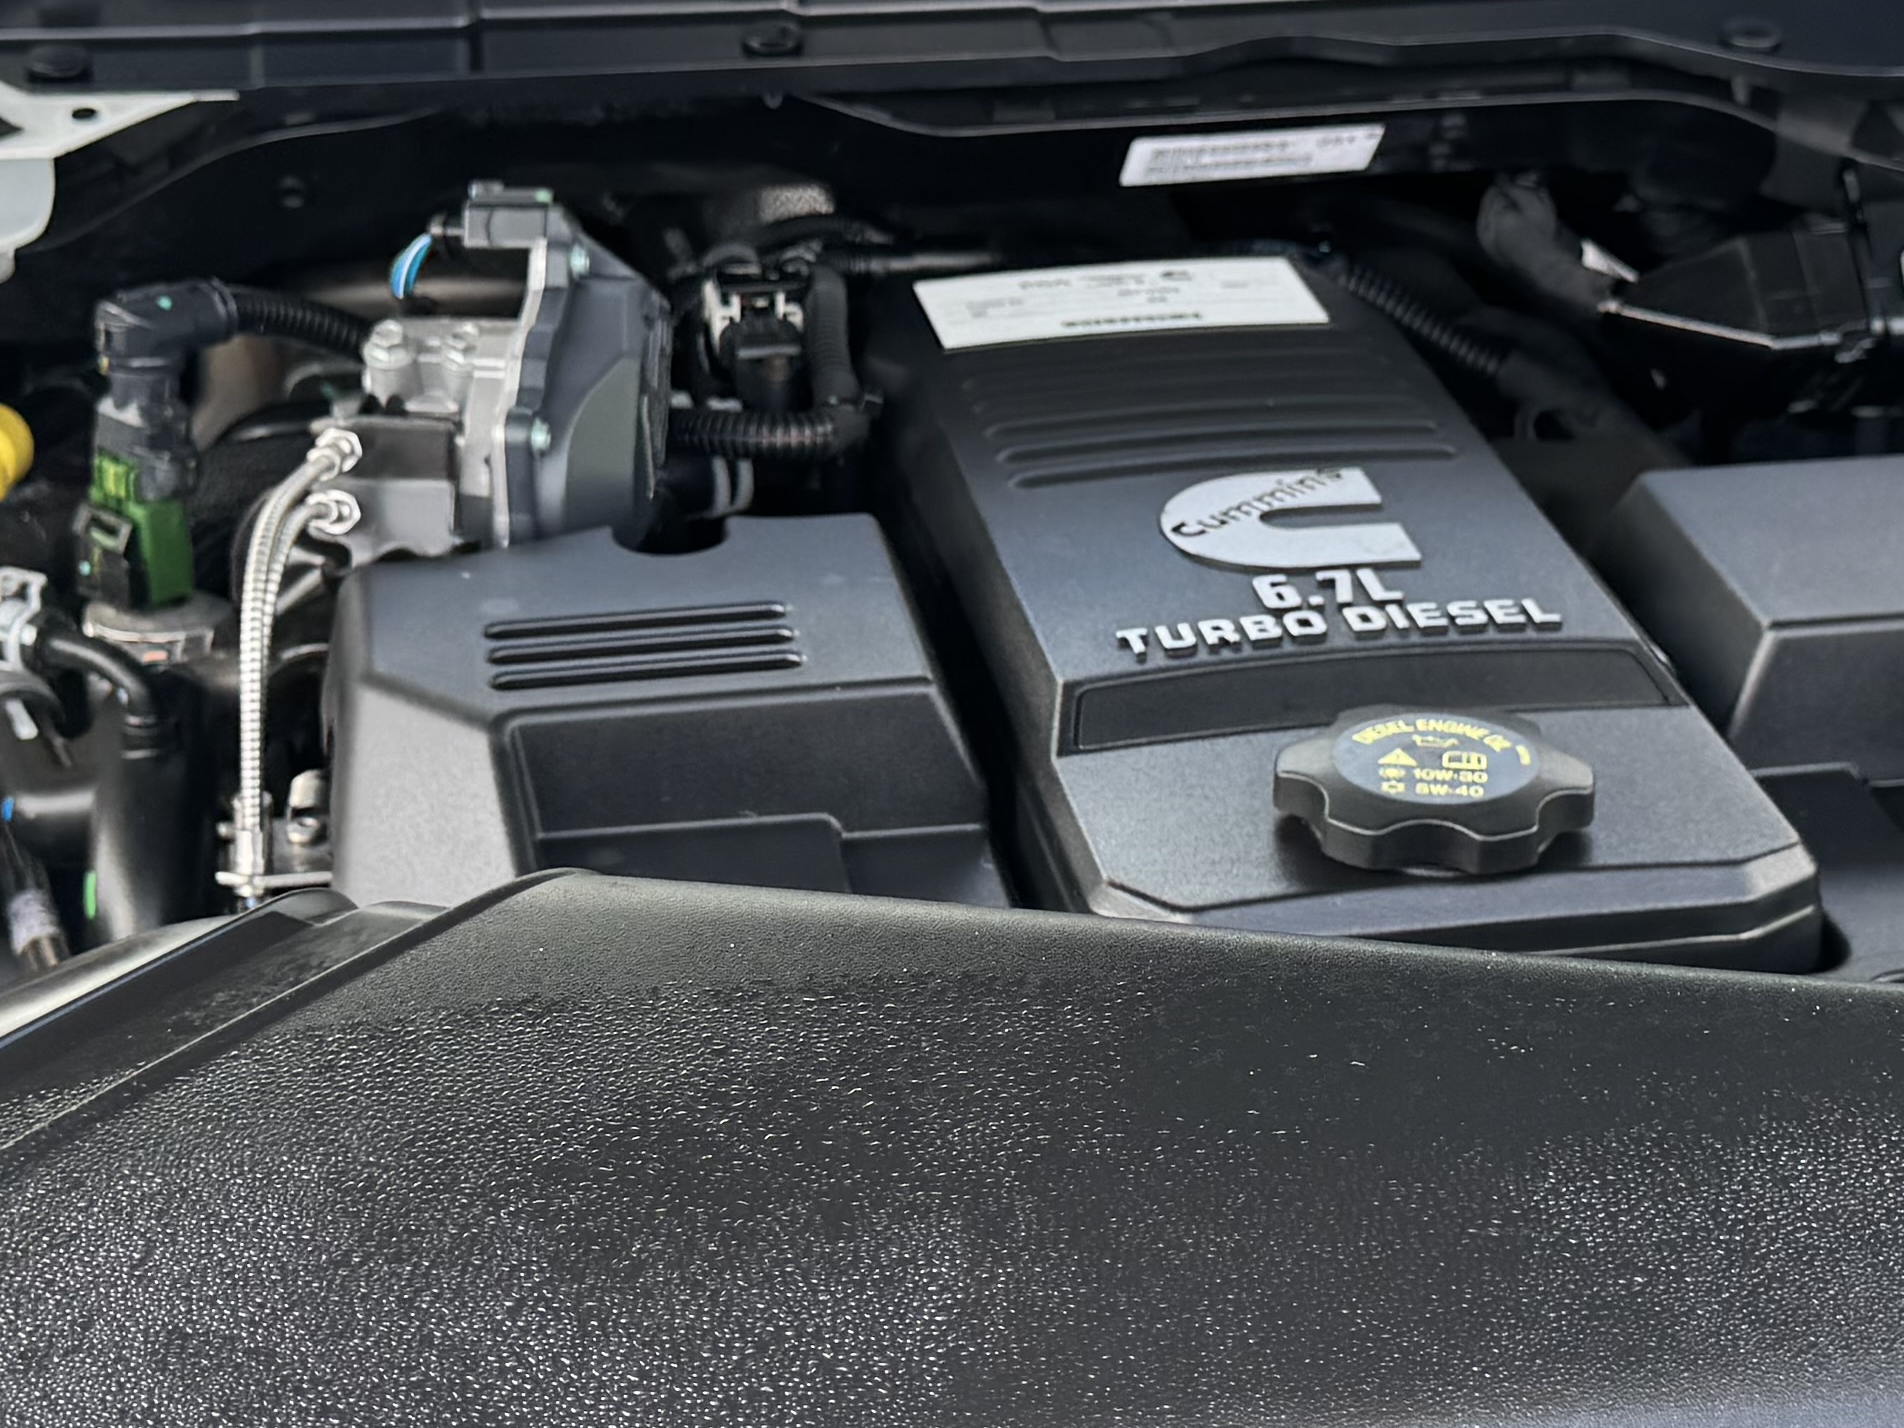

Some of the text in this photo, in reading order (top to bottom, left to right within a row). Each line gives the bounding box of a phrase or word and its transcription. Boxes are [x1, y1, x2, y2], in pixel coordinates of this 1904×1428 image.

[1171, 468, 1344, 538] Cummins
[1252, 568, 1405, 610] 6.7L
[1116, 597, 1563, 658] TURBO DIESEL
